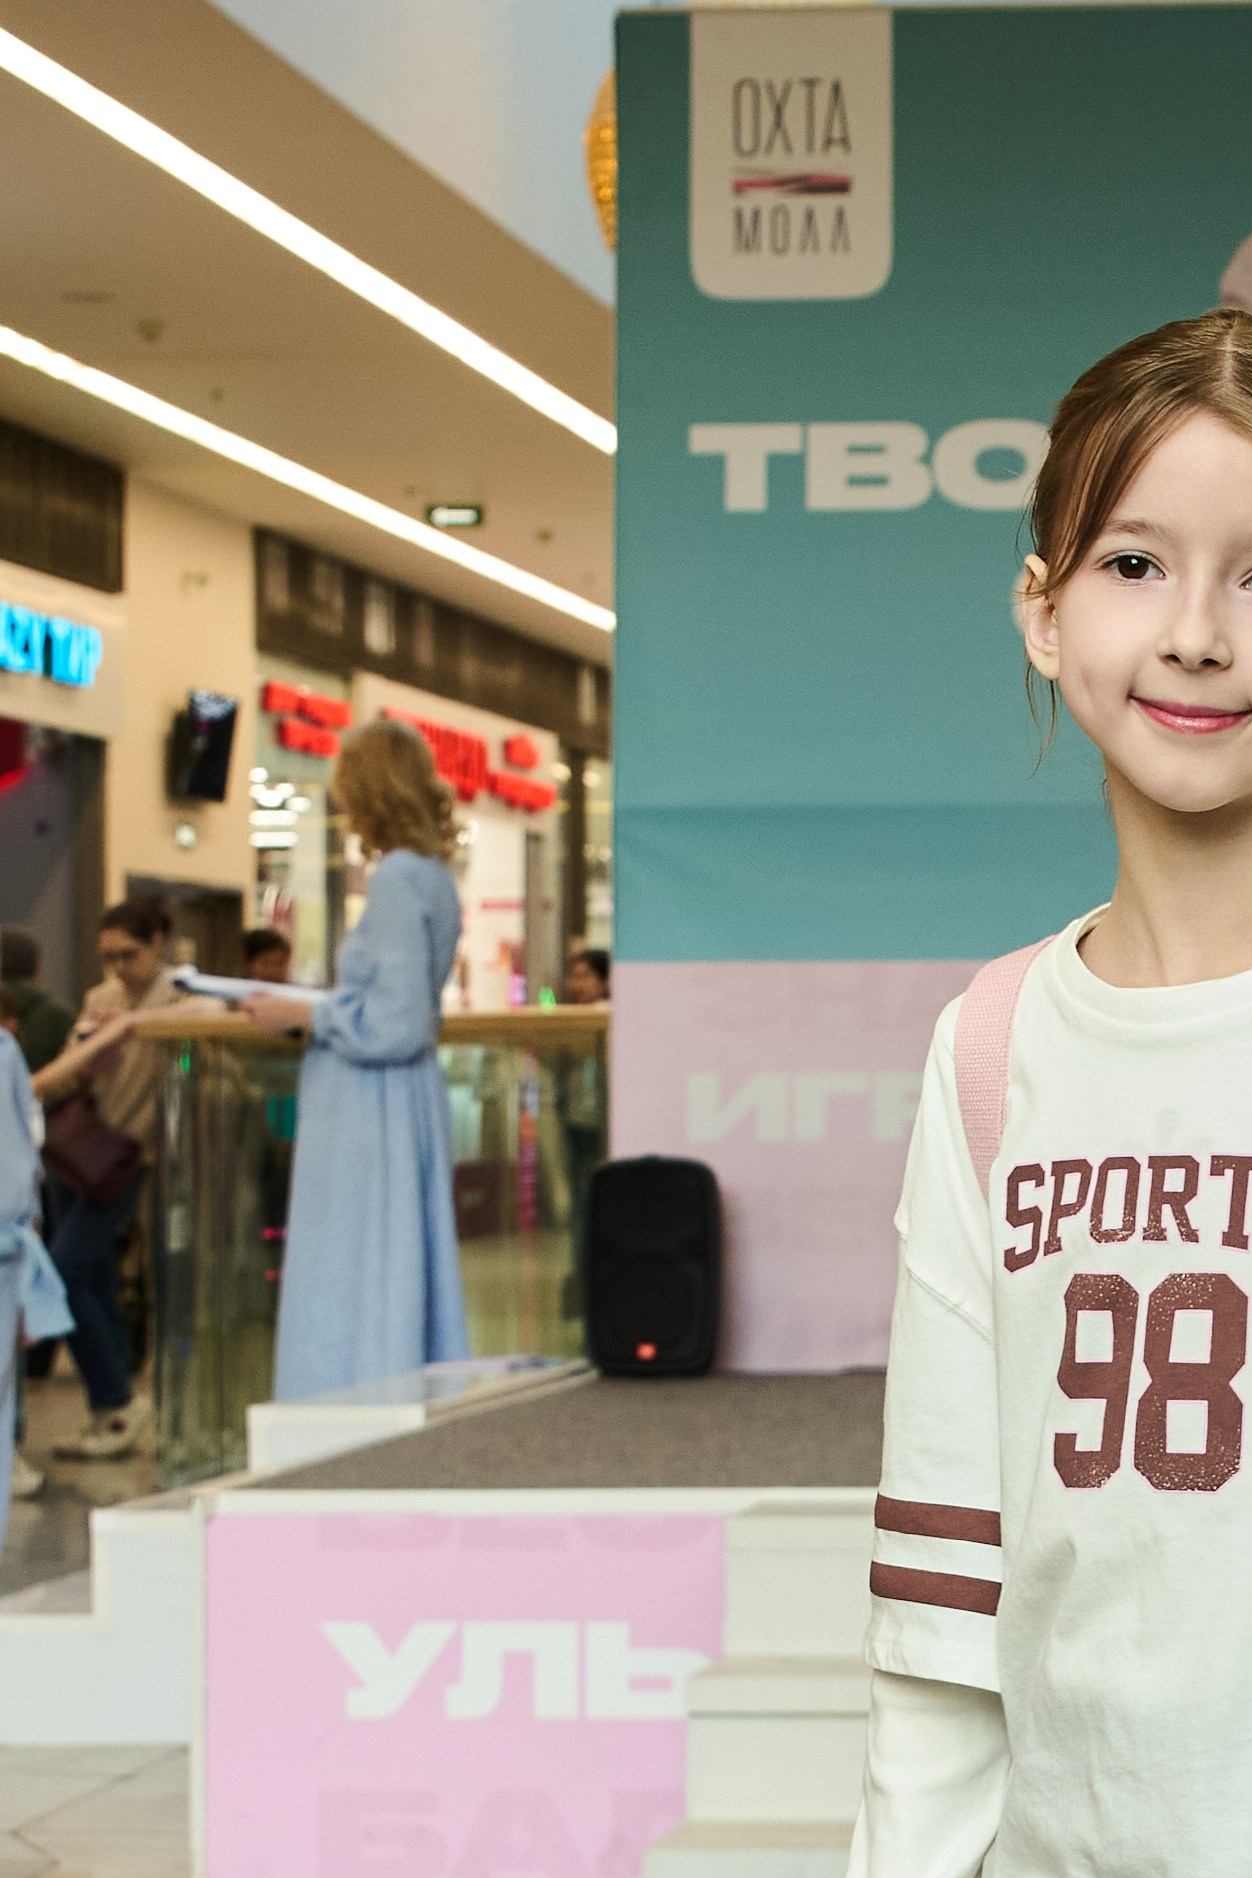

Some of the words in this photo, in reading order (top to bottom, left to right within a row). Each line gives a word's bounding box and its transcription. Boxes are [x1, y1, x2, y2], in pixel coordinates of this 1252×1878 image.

[731, 77, 853, 157] ОХТА
[732, 204, 852, 256] МОЛЛ
[1053, 1272, 1250, 1493] 98
